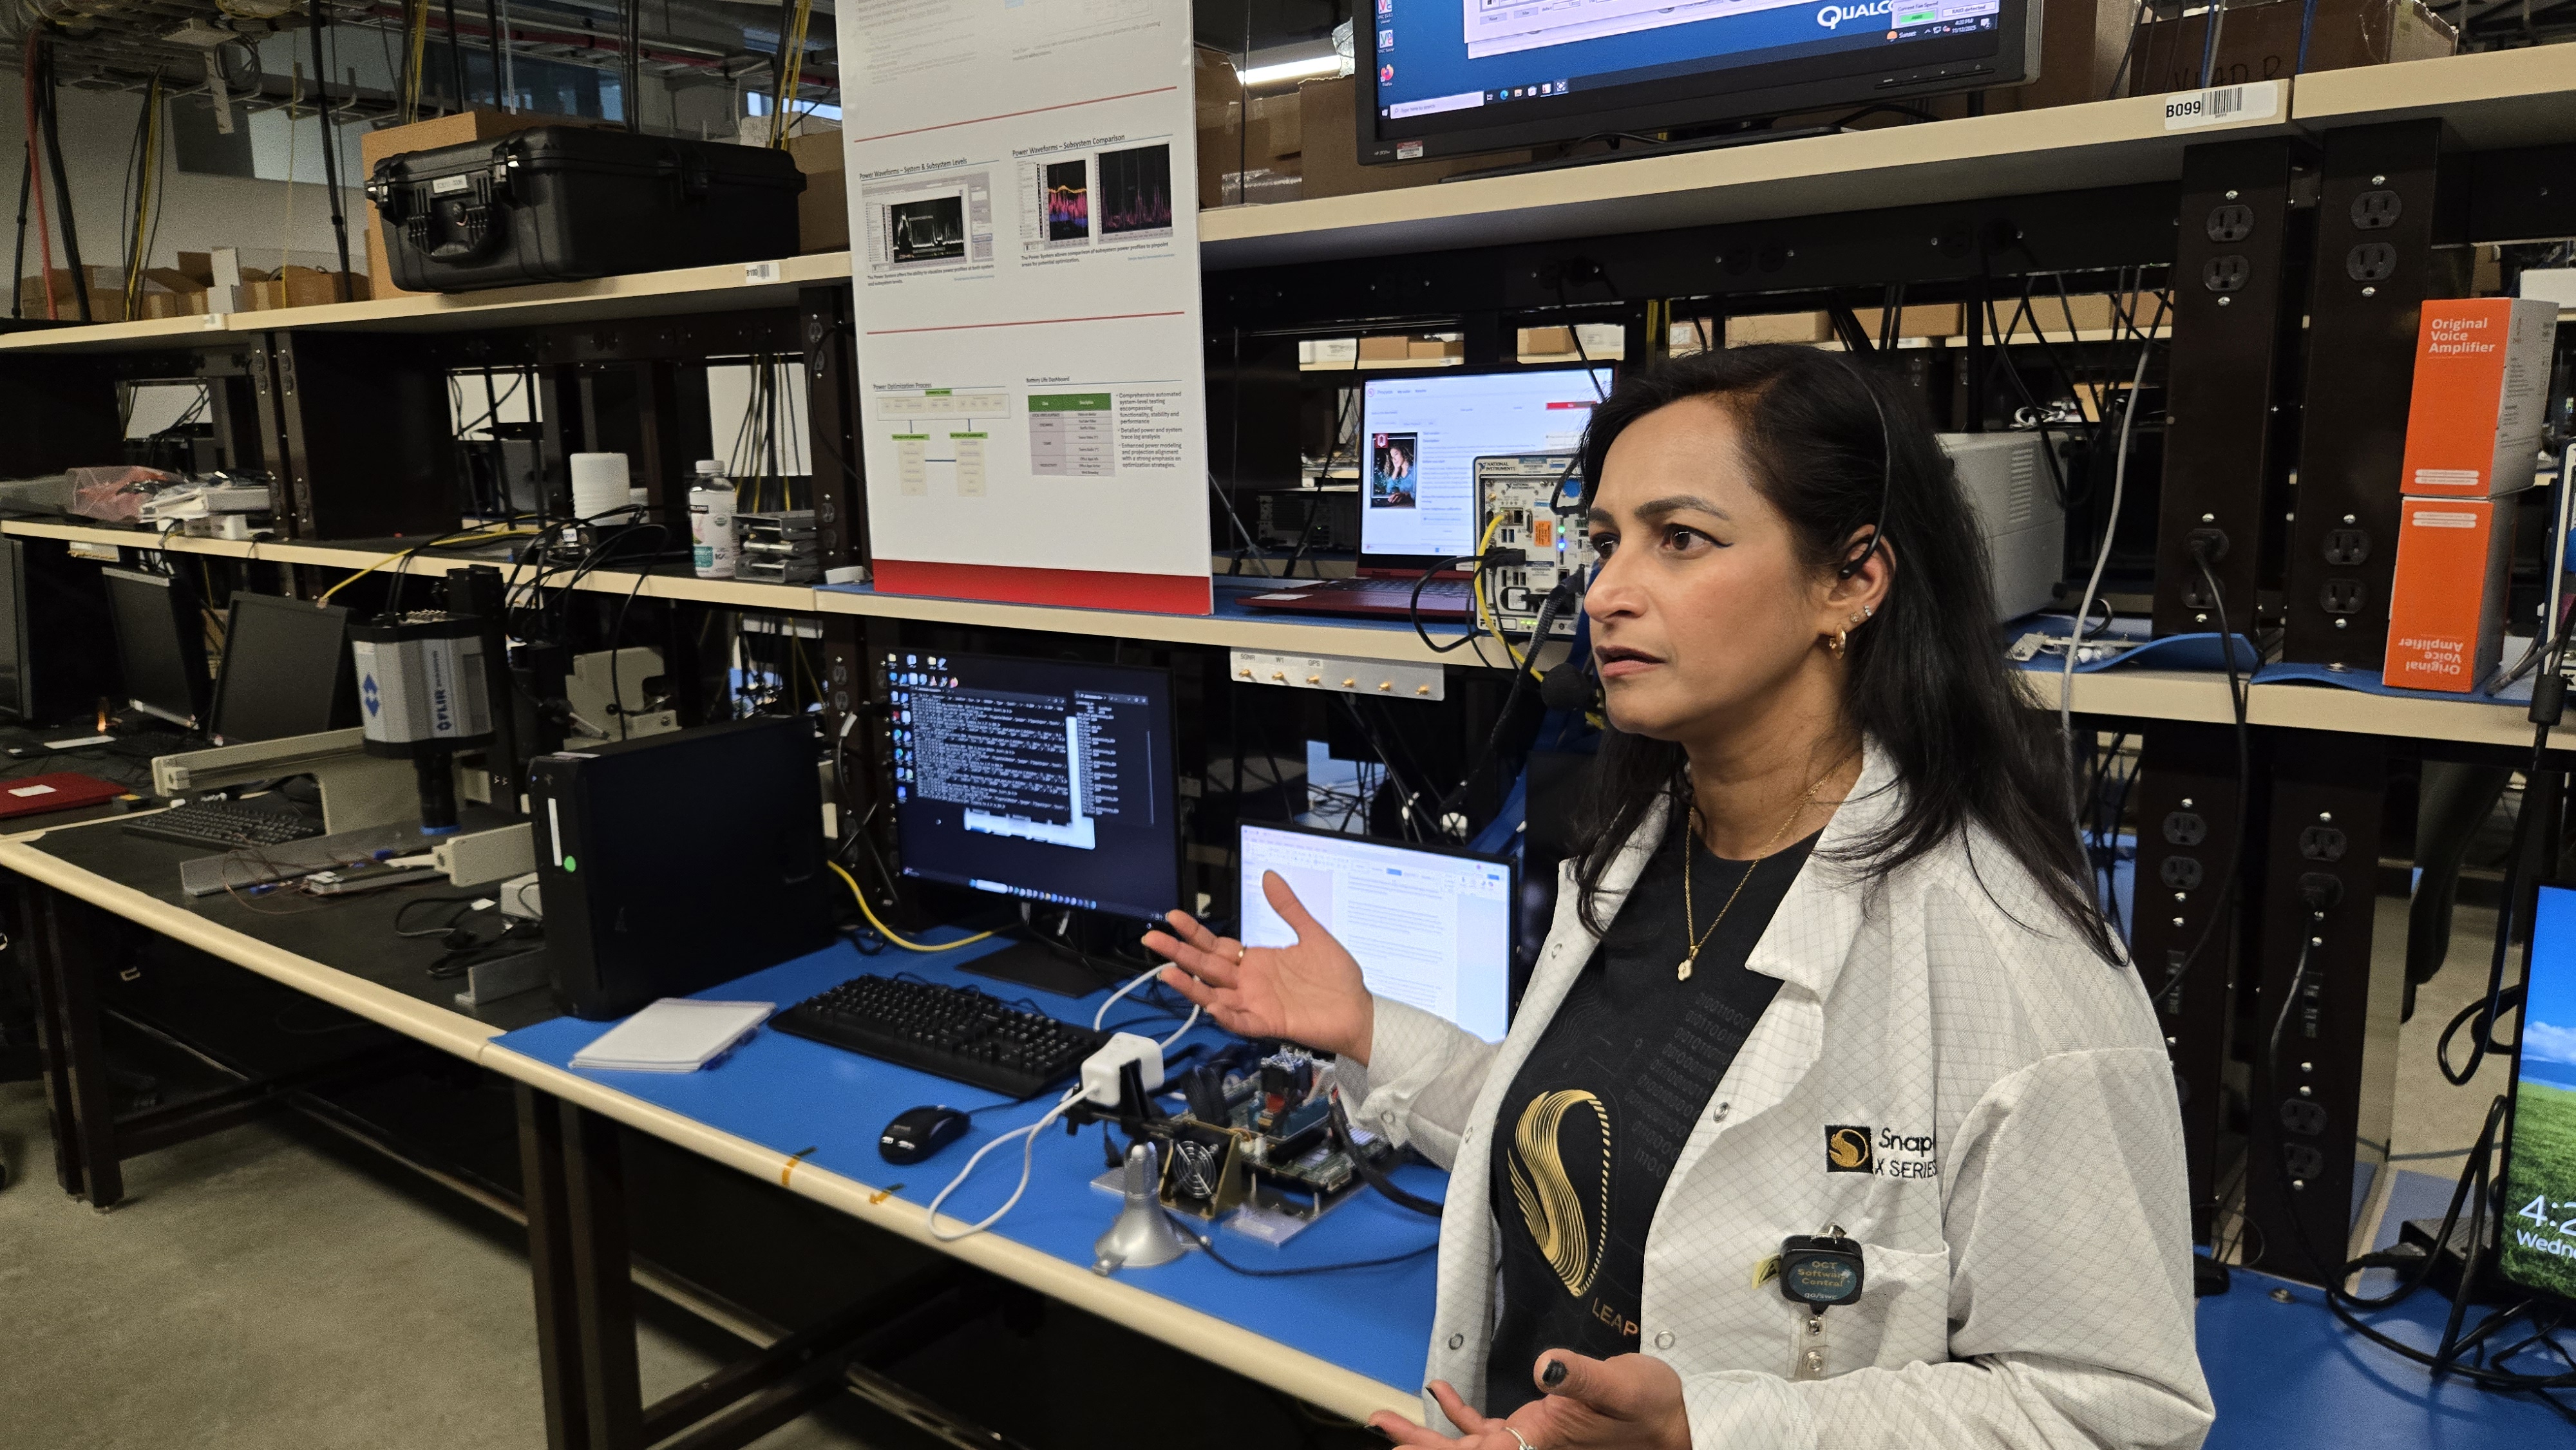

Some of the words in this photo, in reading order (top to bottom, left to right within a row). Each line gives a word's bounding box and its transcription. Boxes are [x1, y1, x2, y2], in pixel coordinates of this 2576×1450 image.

[2166, 100, 2201, 118] B099
[1030, 145, 1058, 155] Waveforms
[1063, 140, 1091, 149] Subsystem
[1093, 135, 1125, 146] Comparison
[875, 169, 899, 177] Waveforms
[904, 165, 920, 173] System
[926, 160, 952, 170] Subsystem
[952, 157, 967, 165] Levels
[2432, 317, 2488, 330] Original
[2430, 331, 2468, 341] Voice
[2429, 343, 2496, 355] Amplifier
[2399, 637, 2463, 652] Amplifier
[2424, 652, 2461, 663] Voice
[2405, 661, 2460, 675] Original
[435, 690, 448, 720] FLIR
[1879, 1127, 1934, 1157] Snap
[1875, 1158, 1884, 1176] X
[1889, 1160, 1937, 1179] SERIES
[1797, 1268, 1846, 1279] Softwar
[1593, 1297, 1638, 1335] LEAP
